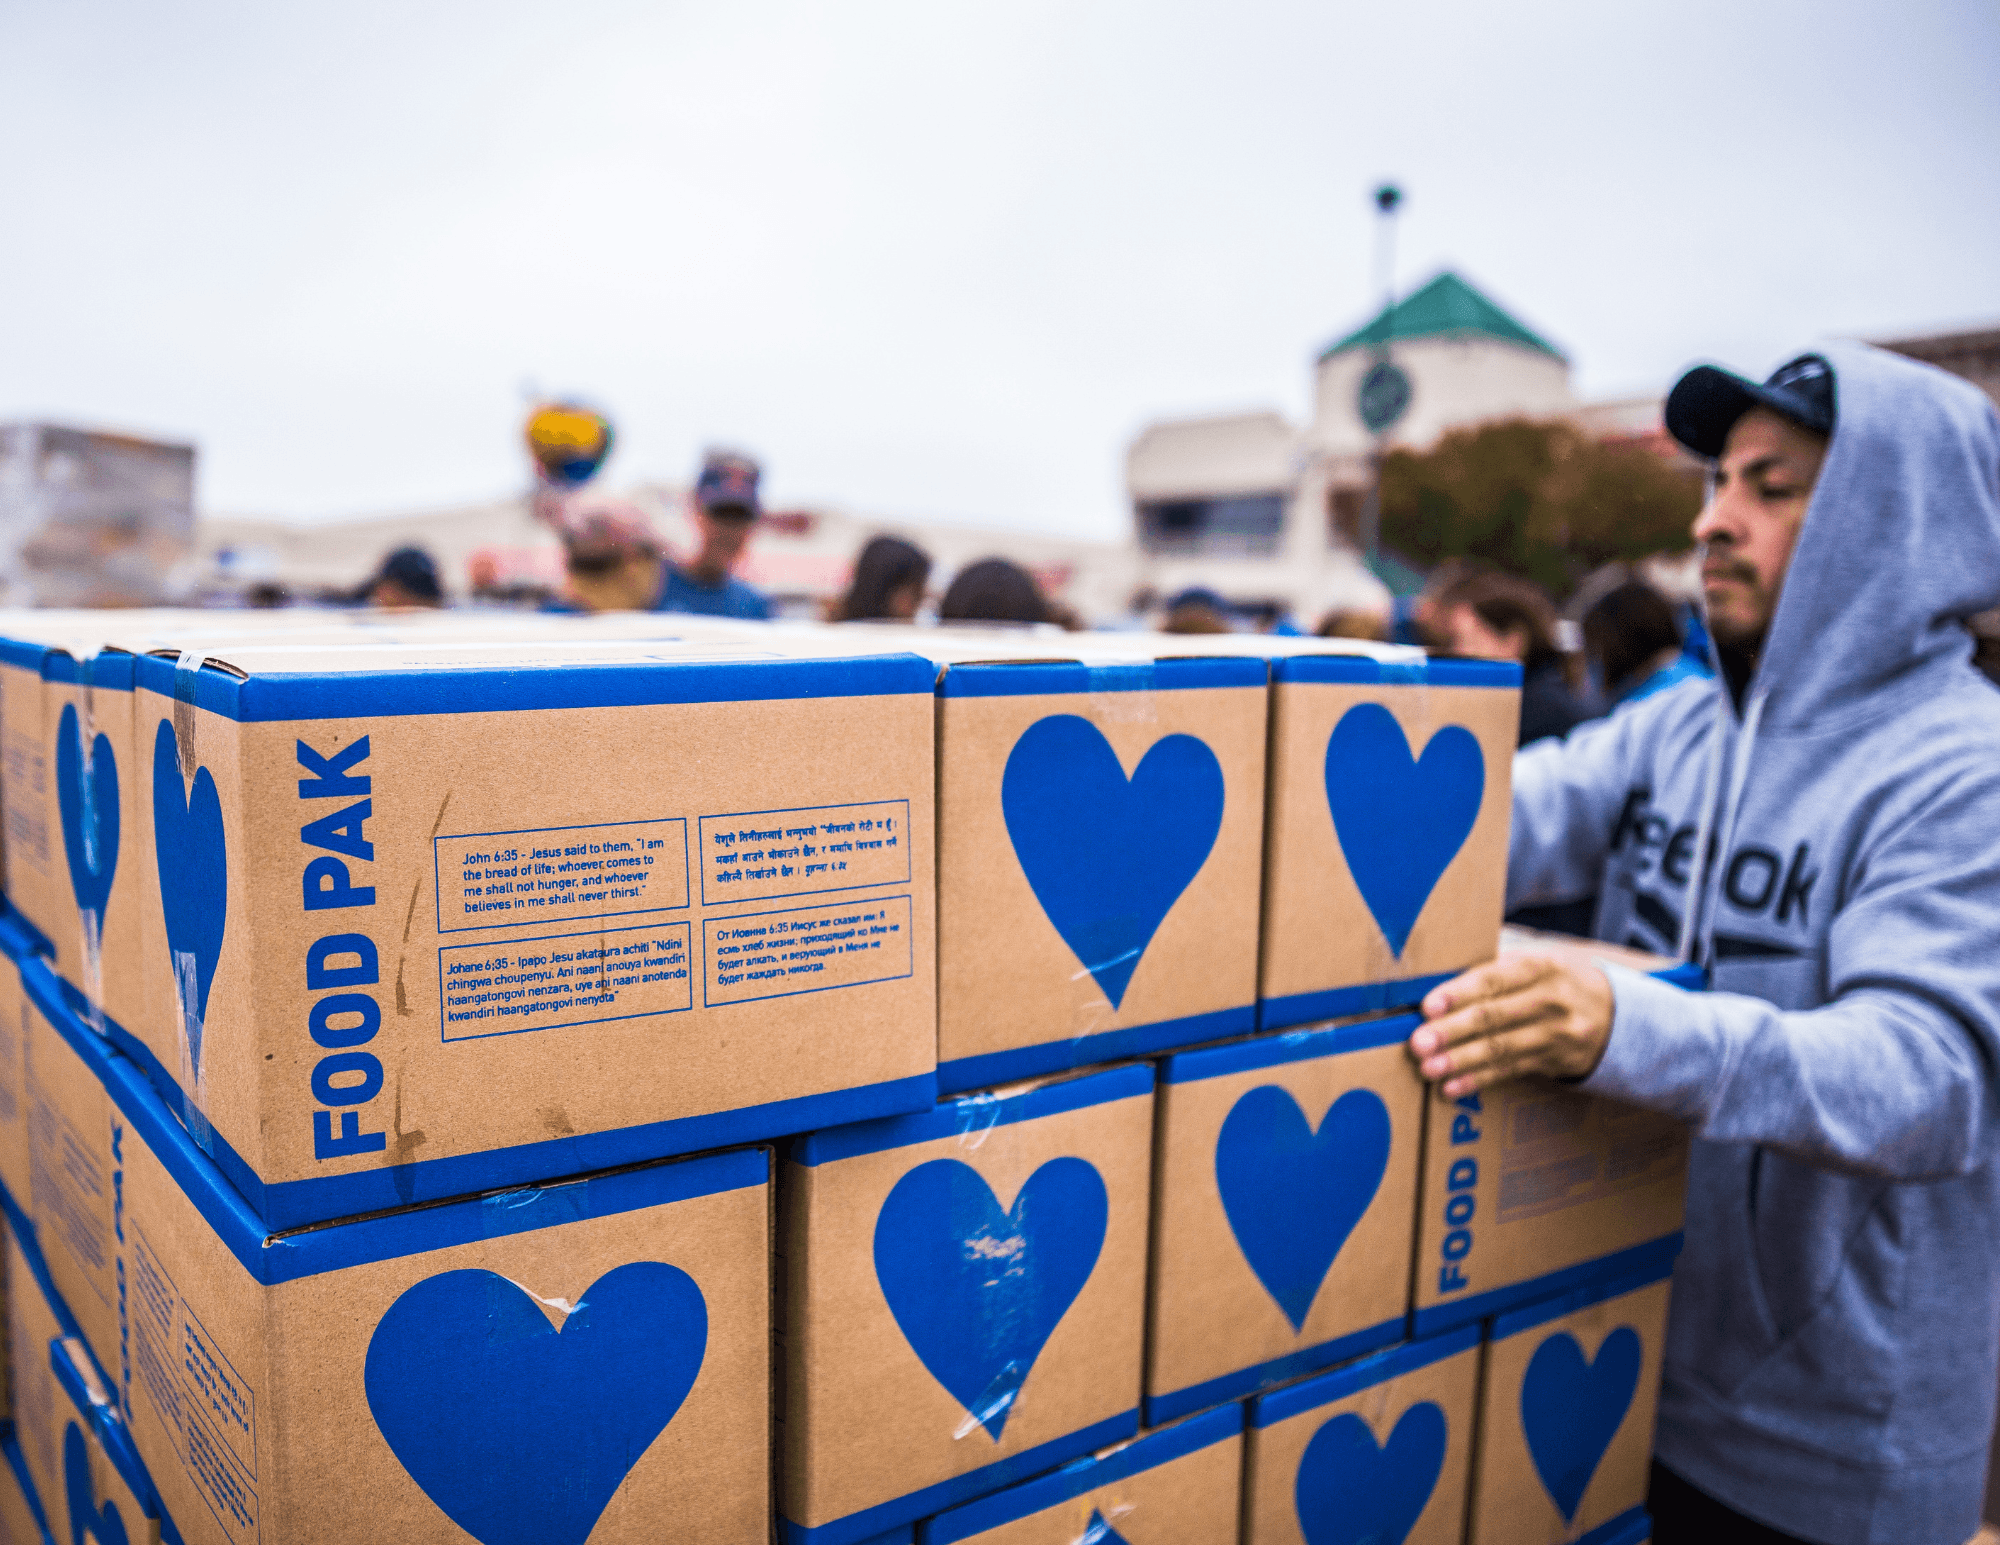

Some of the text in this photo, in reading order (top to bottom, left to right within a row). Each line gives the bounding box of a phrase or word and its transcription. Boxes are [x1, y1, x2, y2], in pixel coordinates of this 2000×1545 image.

[463, 852, 491, 865] John
[494, 849, 518, 862] 6:35
[529, 848, 562, 860] Jesus
[564, 844, 587, 856] said
[589, 844, 600, 854] to
[603, 841, 634, 852] them,
[647, 840, 664, 849] am
[463, 855, 654, 881] the bread of life; whoever comes to
[464, 872, 649, 897] me shall not hunger, and whoever
[465, 900, 512, 913] believes
[514, 897, 525, 908] in
[528, 897, 546, 907] me
[548, 892, 575, 905] shall
[578, 891, 608, 902] never
[296, 733, 387, 1160] FOOD PAK
[446, 962, 483, 975] Johane
[518, 956, 547, 969] Ipapo
[549, 951, 574, 964] Jesu
[575, 948, 621, 961] akataura
[623, 941, 650, 955] achiti
[447, 953, 686, 991] chingwa choupenyu. Ani naani anouya kwandiri
[447, 968, 687, 1006] haangatongovi nenzara, uye ani naani anotenda
[448, 1006, 495, 1022] kwandiri
[497, 996, 573, 1016] haangatongovi
[1438, 1155, 1479, 1294] FOOD
